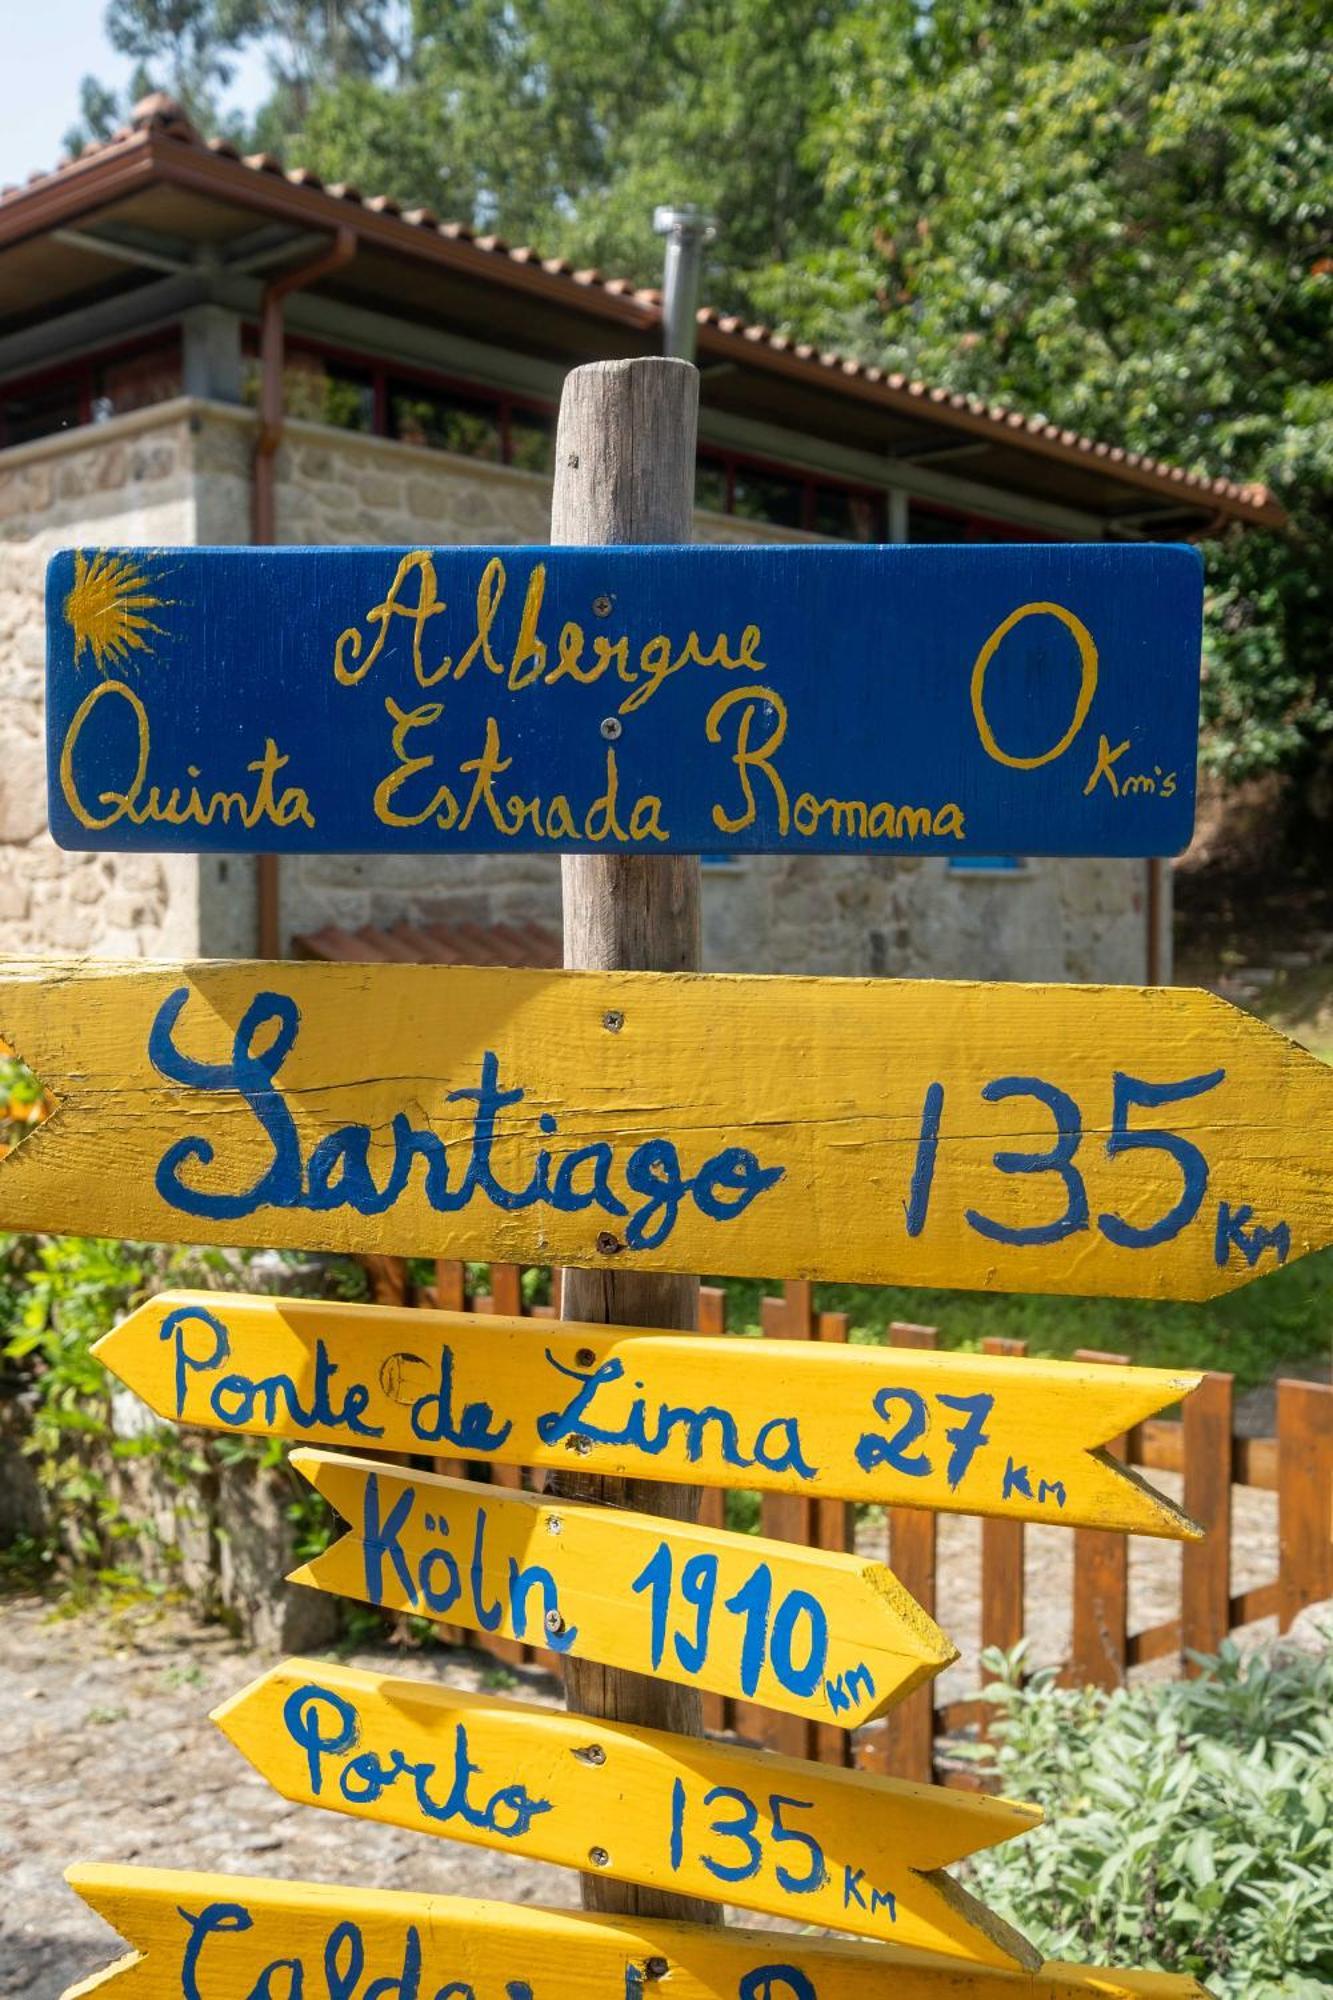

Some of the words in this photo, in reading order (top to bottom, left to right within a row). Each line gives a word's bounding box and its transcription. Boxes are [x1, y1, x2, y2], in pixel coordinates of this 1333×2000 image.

[335, 550, 766, 714] Albergue
[60, 680, 315, 829] Quinta
[373, 697, 669, 841] Estrada
[706, 685, 965, 839] Romana
[149, 986, 786, 1250] Santiago
[903, 1068, 1226, 1249] 135
[159, 1306, 384, 1438] Ponte
[411, 1344, 512, 1450] de
[537, 1347, 818, 1480] Lima
[854, 1387, 996, 1492] 27
[364, 1472, 578, 1653] Köln
[632, 1542, 828, 1698] 1910
[284, 1683, 554, 1837] Porto
[670, 1777, 832, 1894] 135
